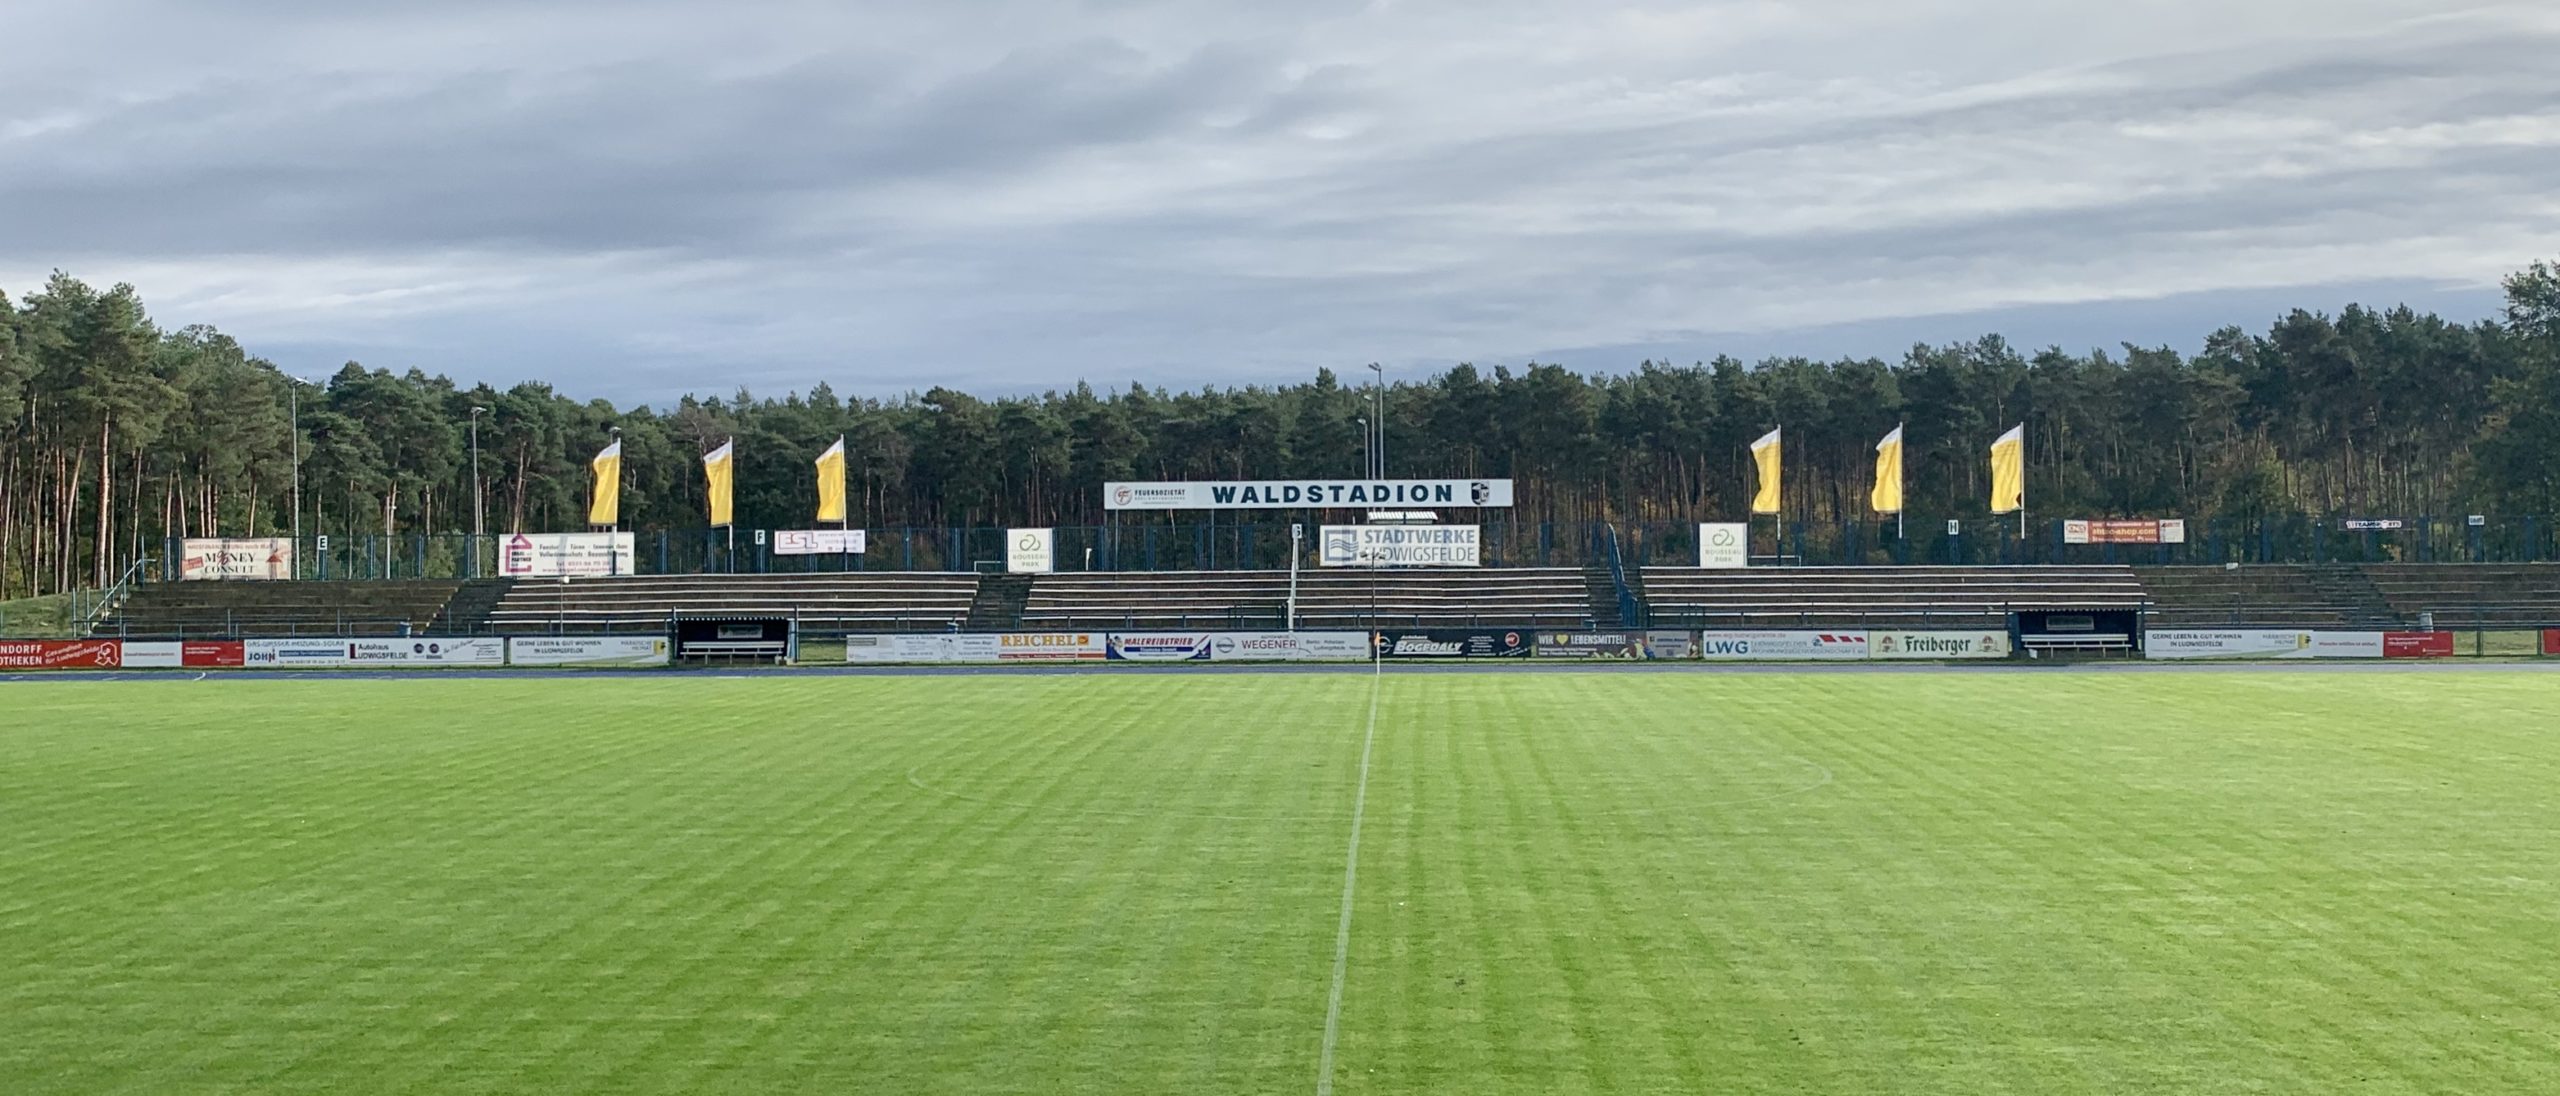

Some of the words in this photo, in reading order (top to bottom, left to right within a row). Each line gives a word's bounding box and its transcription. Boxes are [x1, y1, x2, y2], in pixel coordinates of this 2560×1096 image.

[1211, 484, 1453, 504] WALDSTADION
[1950, 521, 1957, 533] H
[757, 531, 764, 543] F
[1364, 529, 1475, 544] STADTWERKE
[320, 537, 326, 549] E
[1001, 635, 1077, 647] REICHEL
[1242, 639, 1297, 649] WEGENER
[1538, 634, 1554, 645] WIR
[1570, 634, 1626, 645] LEBENSMITTEL!
[1904, 636, 1971, 655] Freiberger
[358, 643, 390, 651] Autohaus
[1706, 640, 1748, 654] LWG
